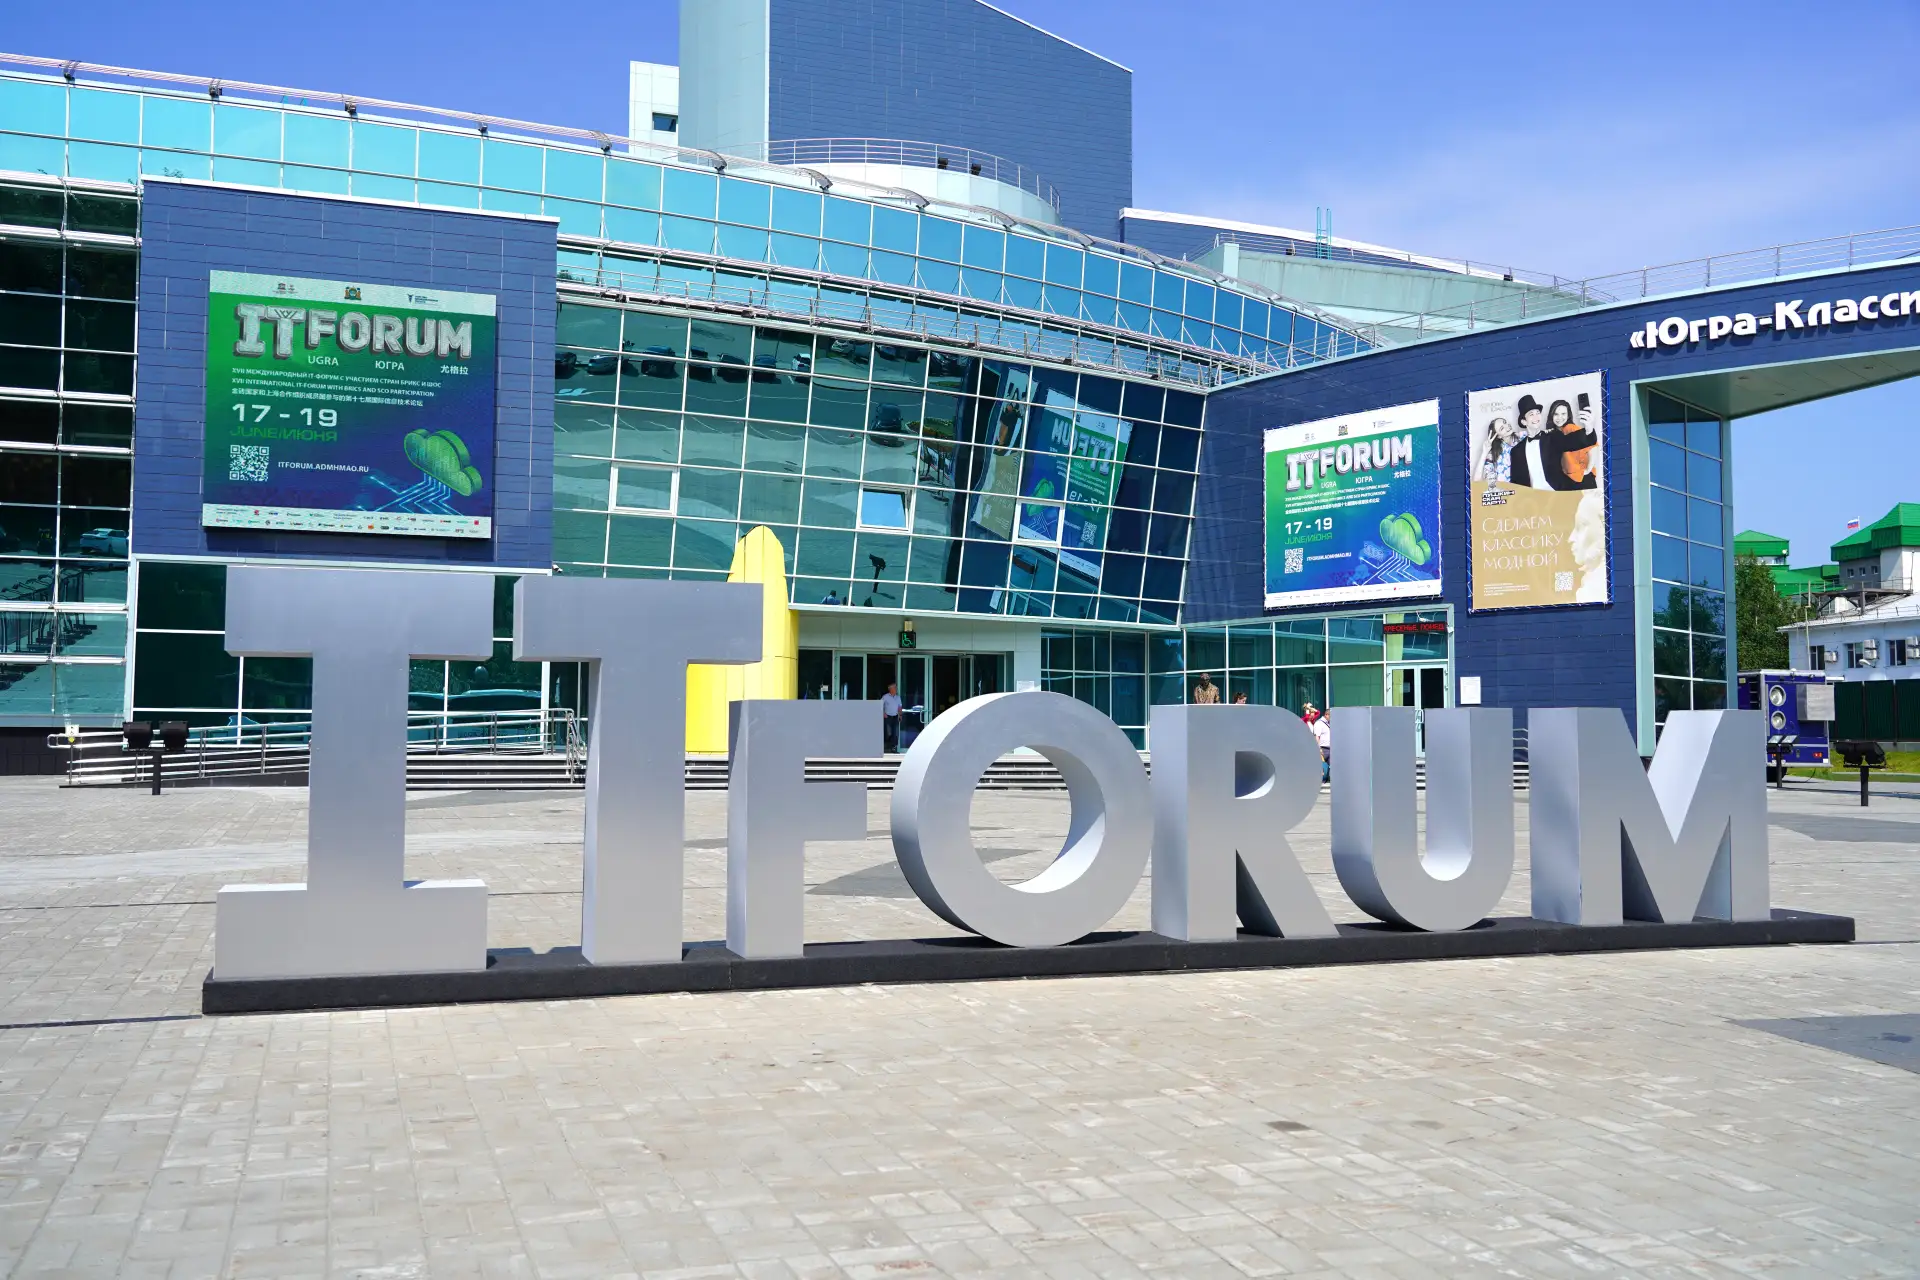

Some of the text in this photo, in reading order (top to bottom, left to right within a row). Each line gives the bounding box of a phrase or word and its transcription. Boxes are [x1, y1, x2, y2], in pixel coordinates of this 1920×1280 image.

[233, 303, 473, 360] ITFORUM
[308, 354, 339, 366] UGRA
[375, 360, 405, 371] ЮГРА
[245, 369, 308, 378] МЕЖДУНАРОДНЫЙ
[308, 373, 339, 381] IT-ФОРУМ
[345, 376, 379, 384] УЧАСТИЕМ
[440, 365, 469, 375] 尤格拉
[245, 378, 295, 388] INTERNATIONAL
[296, 382, 327, 390] IT-FORUM
[390, 389, 435, 397] PARTICIPATION
[231, 403, 272, 423] 17
[299, 408, 338, 427] 19
[277, 461, 370, 473] ITFORUM.ADMHMAO.RU
[1285, 434, 1413, 492] ITFORUM
[1320, 481, 1337, 489] UGRA
[1355, 475, 1373, 484] ЮГРА
[1285, 521, 1303, 535] 17
[1315, 517, 1333, 531] 19
[1482, 516, 1553, 535] СДЕЛАЕМ
[1483, 533, 1564, 552] КЛАССИКУ
[1483, 549, 1558, 571] МОДНОЙ
